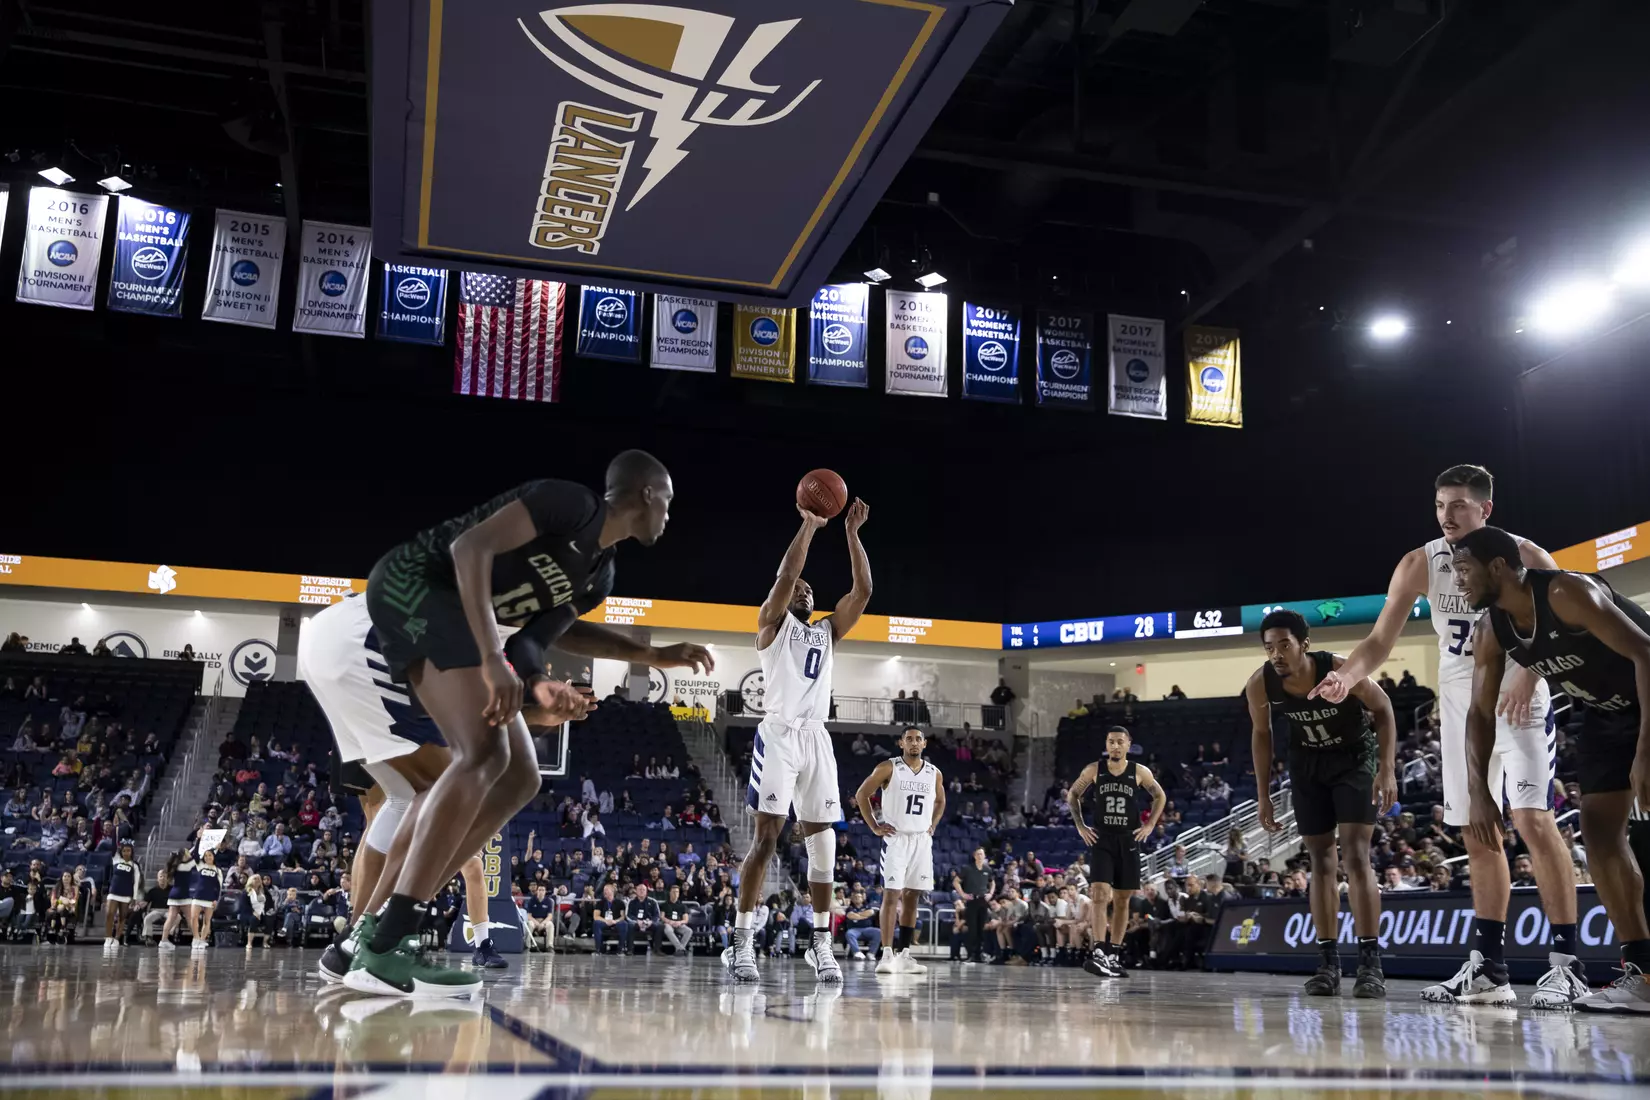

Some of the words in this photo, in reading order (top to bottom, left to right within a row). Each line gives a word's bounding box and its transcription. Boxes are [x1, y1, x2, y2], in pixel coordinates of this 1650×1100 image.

[528, 100, 645, 256] LANCERS
[47, 201, 89, 215] 2016
[49, 216, 82, 227] MEN'S
[31, 225, 99, 240] BASKETBALL
[135, 224, 170, 235] MEN'S
[231, 221, 270, 236] 2015
[232, 237, 264, 247] MEN'S
[317, 232, 355, 246] 2014
[50, 252, 76, 261] NCAA
[216, 245, 280, 260] BASKETBALL
[319, 247, 350, 258] MEN'S
[135, 263, 165, 271] PacWest
[303, 256, 366, 270] BASKETBALL
[34, 270, 77, 282] DIVISION
[233, 272, 259, 281] NCAA
[385, 263, 447, 278] BASKETBALL
[24, 277, 93, 293] TOURNAMENT
[114, 282, 180, 297] TOURNAMENT
[322, 281, 346, 291] NCAA
[117, 292, 175, 305] CHAMPIONS
[214, 289, 263, 301] DIVISION
[400, 293, 426, 301] PacWest
[658, 295, 715, 307] BASKETBALL
[216, 300, 252, 311] SWEET
[255, 304, 266, 313] 16
[308, 300, 348, 311] DIVISION
[737, 305, 792, 317] BASKETBALL
[900, 300, 932, 313] 2016
[299, 309, 363, 321] TOURNAMENT
[381, 311, 441, 325] CHAMPIONS
[810, 311, 866, 324] BASKETBALL
[976, 307, 1009, 320] 2017
[675, 320, 698, 329] NCAA
[970, 320, 1013, 331] WOMEN'S
[1049, 316, 1081, 329] 2017
[581, 329, 639, 343] CHAMPIONS
[753, 330, 778, 339] NCAA
[966, 329, 1020, 342] BASKETBALL
[1044, 328, 1085, 339] WOMEN'S
[1121, 324, 1153, 338] 2017
[657, 336, 678, 346] WEST
[680, 339, 713, 349] REGION
[825, 338, 850, 346] PacWest
[1039, 336, 1092, 349] BASKETBALL
[1116, 338, 1156, 349] WOMEN'S
[659, 345, 710, 357] CHAMPIONS
[740, 347, 780, 357] DIVISION
[908, 346, 928, 355] NCAA
[1113, 346, 1162, 358] BASKETBALL
[740, 356, 786, 367] NATIONAL
[810, 357, 864, 369] CHAMPIONS
[736, 364, 776, 374] RUNNER
[778, 367, 790, 375] UP
[897, 364, 931, 373] DIVISION
[890, 371, 944, 382] TOURNAMENT
[966, 373, 1019, 385] CHAMPIONS
[1039, 381, 1091, 393] TOURNAMENT
[1114, 384, 1133, 395] WEST
[1134, 387, 1162, 397] REGION
[1042, 389, 1088, 401] CHAMPIONS
[1116, 393, 1160, 404] CHAMPIONS
[807, 479, 833, 510] Wilson
[301, 576, 352, 588] RIVERSIDE
[300, 585, 343, 597] MEDICAL
[299, 595, 331, 605] CLINIC
[492, 582, 541, 619] 15
[606, 597, 652, 609] RIVERSIDE
[606, 606, 645, 617] MEDICAL
[605, 615, 635, 625] CLINIC
[1194, 610, 1223, 629] 6:32
[889, 626, 927, 636] MEDICAL
[1060, 620, 1105, 644] CBU
[1134, 616, 1155, 638] 28
[1033, 636, 1039, 647] 5
[804, 647, 822, 680] 0
[675, 680, 720, 689] EQUIPPED
[689, 688, 718, 697] SERVE
[1561, 681, 1597, 701] 4
[1287, 708, 1339, 722] HICAGO
[1302, 724, 1331, 743] 11
[1100, 782, 1134, 798] CHICAGO
[906, 795, 925, 816] 15
[1106, 797, 1126, 814] 22
[1104, 815, 1129, 827] STATE
